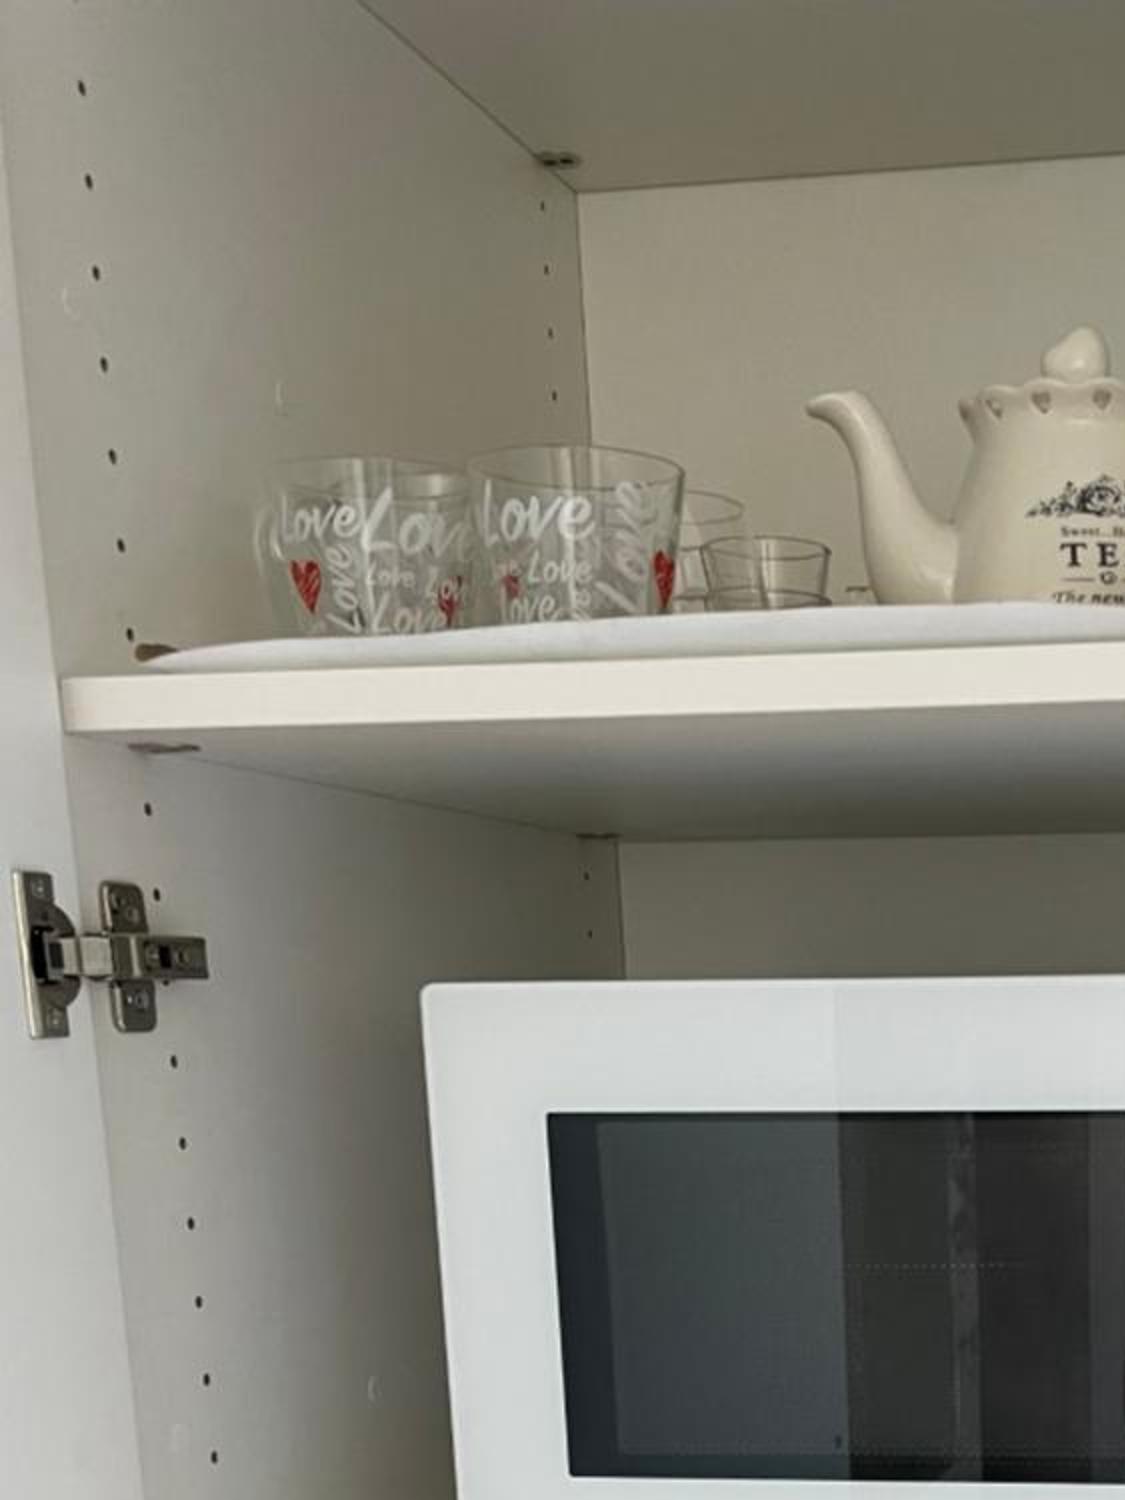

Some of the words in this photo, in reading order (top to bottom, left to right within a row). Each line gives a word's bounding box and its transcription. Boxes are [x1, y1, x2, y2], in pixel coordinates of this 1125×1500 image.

[281, 495, 361, 542] Love
[484, 479, 597, 549] Love
[527, 549, 593, 585] Love
[1053, 589, 1085, 604] The
